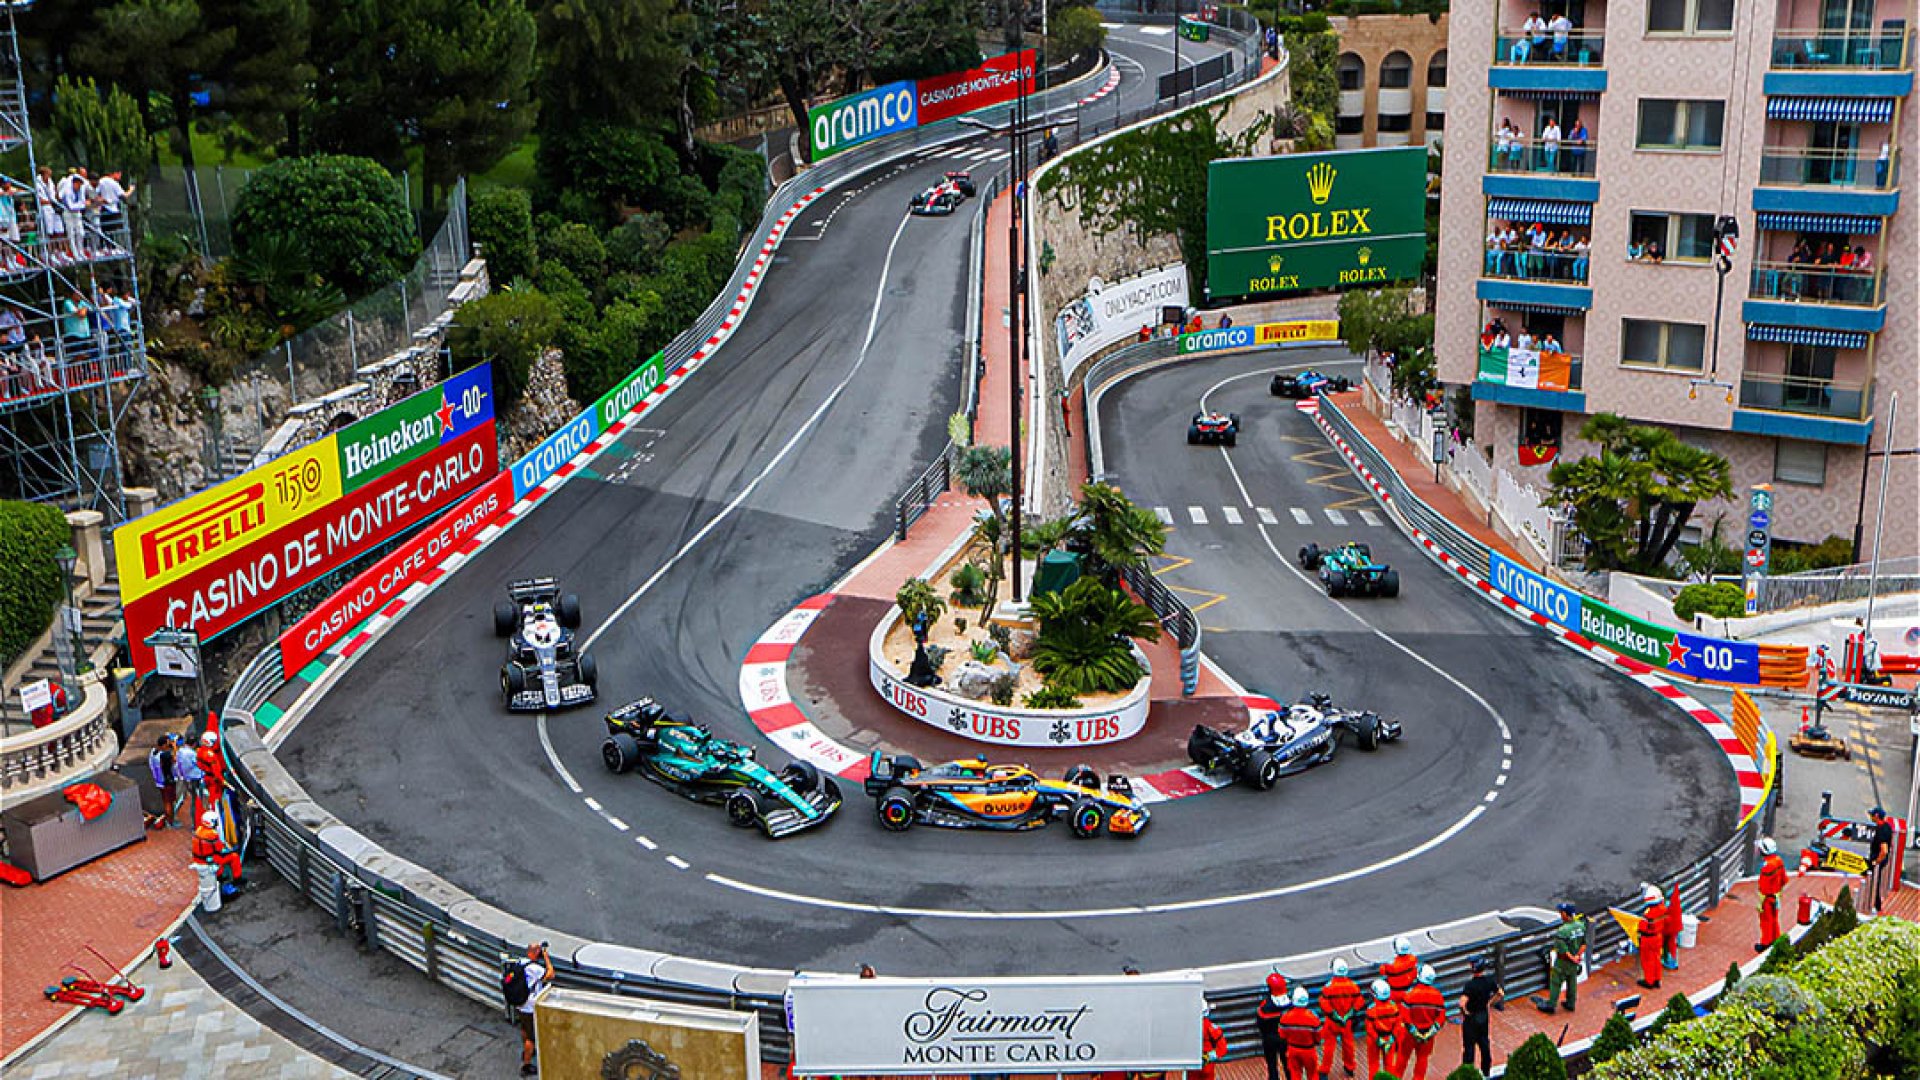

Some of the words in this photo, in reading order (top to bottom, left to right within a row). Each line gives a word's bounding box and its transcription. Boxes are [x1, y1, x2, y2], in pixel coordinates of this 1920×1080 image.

[920, 85, 955, 106] CASINO
[956, 82, 968, 97] DE
[814, 88, 913, 151] aramco
[1265, 208, 1372, 243] ROLEX
[1105, 277, 1182, 318] ONLYYACHT.COM
[1250, 274, 1300, 293] ROLEX
[1339, 266, 1388, 284] ROLEX
[1185, 329, 1247, 351] aramco
[605, 365, 659, 422] aramco
[344, 413, 435, 479] Heineken
[522, 418, 590, 488] aramco
[139, 482, 266, 580] PIRELLI
[274, 457, 322, 511] 150
[166, 552, 278, 630] CASINO
[286, 538, 322, 580] DE
[327, 443, 483, 555] MONTE-CARLO
[304, 586, 376, 652] CASINO
[378, 550, 425, 591] CAFE
[428, 528, 453, 557] DE
[454, 494, 499, 538] PARIS
[1497, 562, 1569, 623] aramco
[1580, 606, 1661, 658] Heineken
[892, 685, 927, 717] UBS
[972, 713, 1022, 740] UBS
[1076, 715, 1120, 742] UBS
[904, 987, 1093, 1043] Fairmont
[903, 1045, 996, 1063] MONTE
[1007, 1043, 1096, 1062] CARLO
